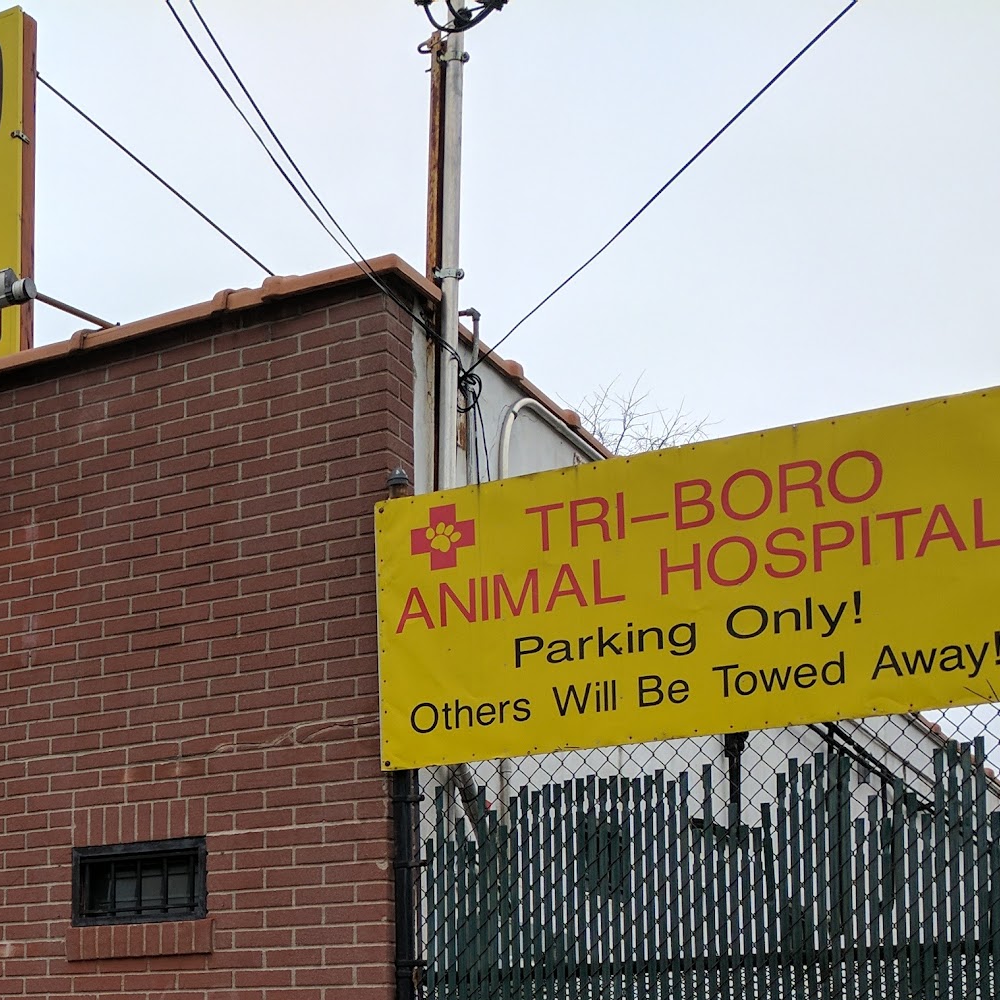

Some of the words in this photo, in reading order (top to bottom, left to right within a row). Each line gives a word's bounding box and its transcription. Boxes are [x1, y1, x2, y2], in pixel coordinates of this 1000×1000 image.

[526, 450, 884, 552] TRI-BORO
[396, 559, 626, 634] ANIMAL
[660, 497, 1000, 596] HOSPITAL
[514, 621, 697, 669] Parking
[726, 591, 863, 640] Only!
[410, 695, 532, 735] Others
[552, 679, 617, 717] Will
[638, 674, 691, 708] Be
[712, 651, 846, 700] Towed
[871, 630, 1000, 679] Away!
